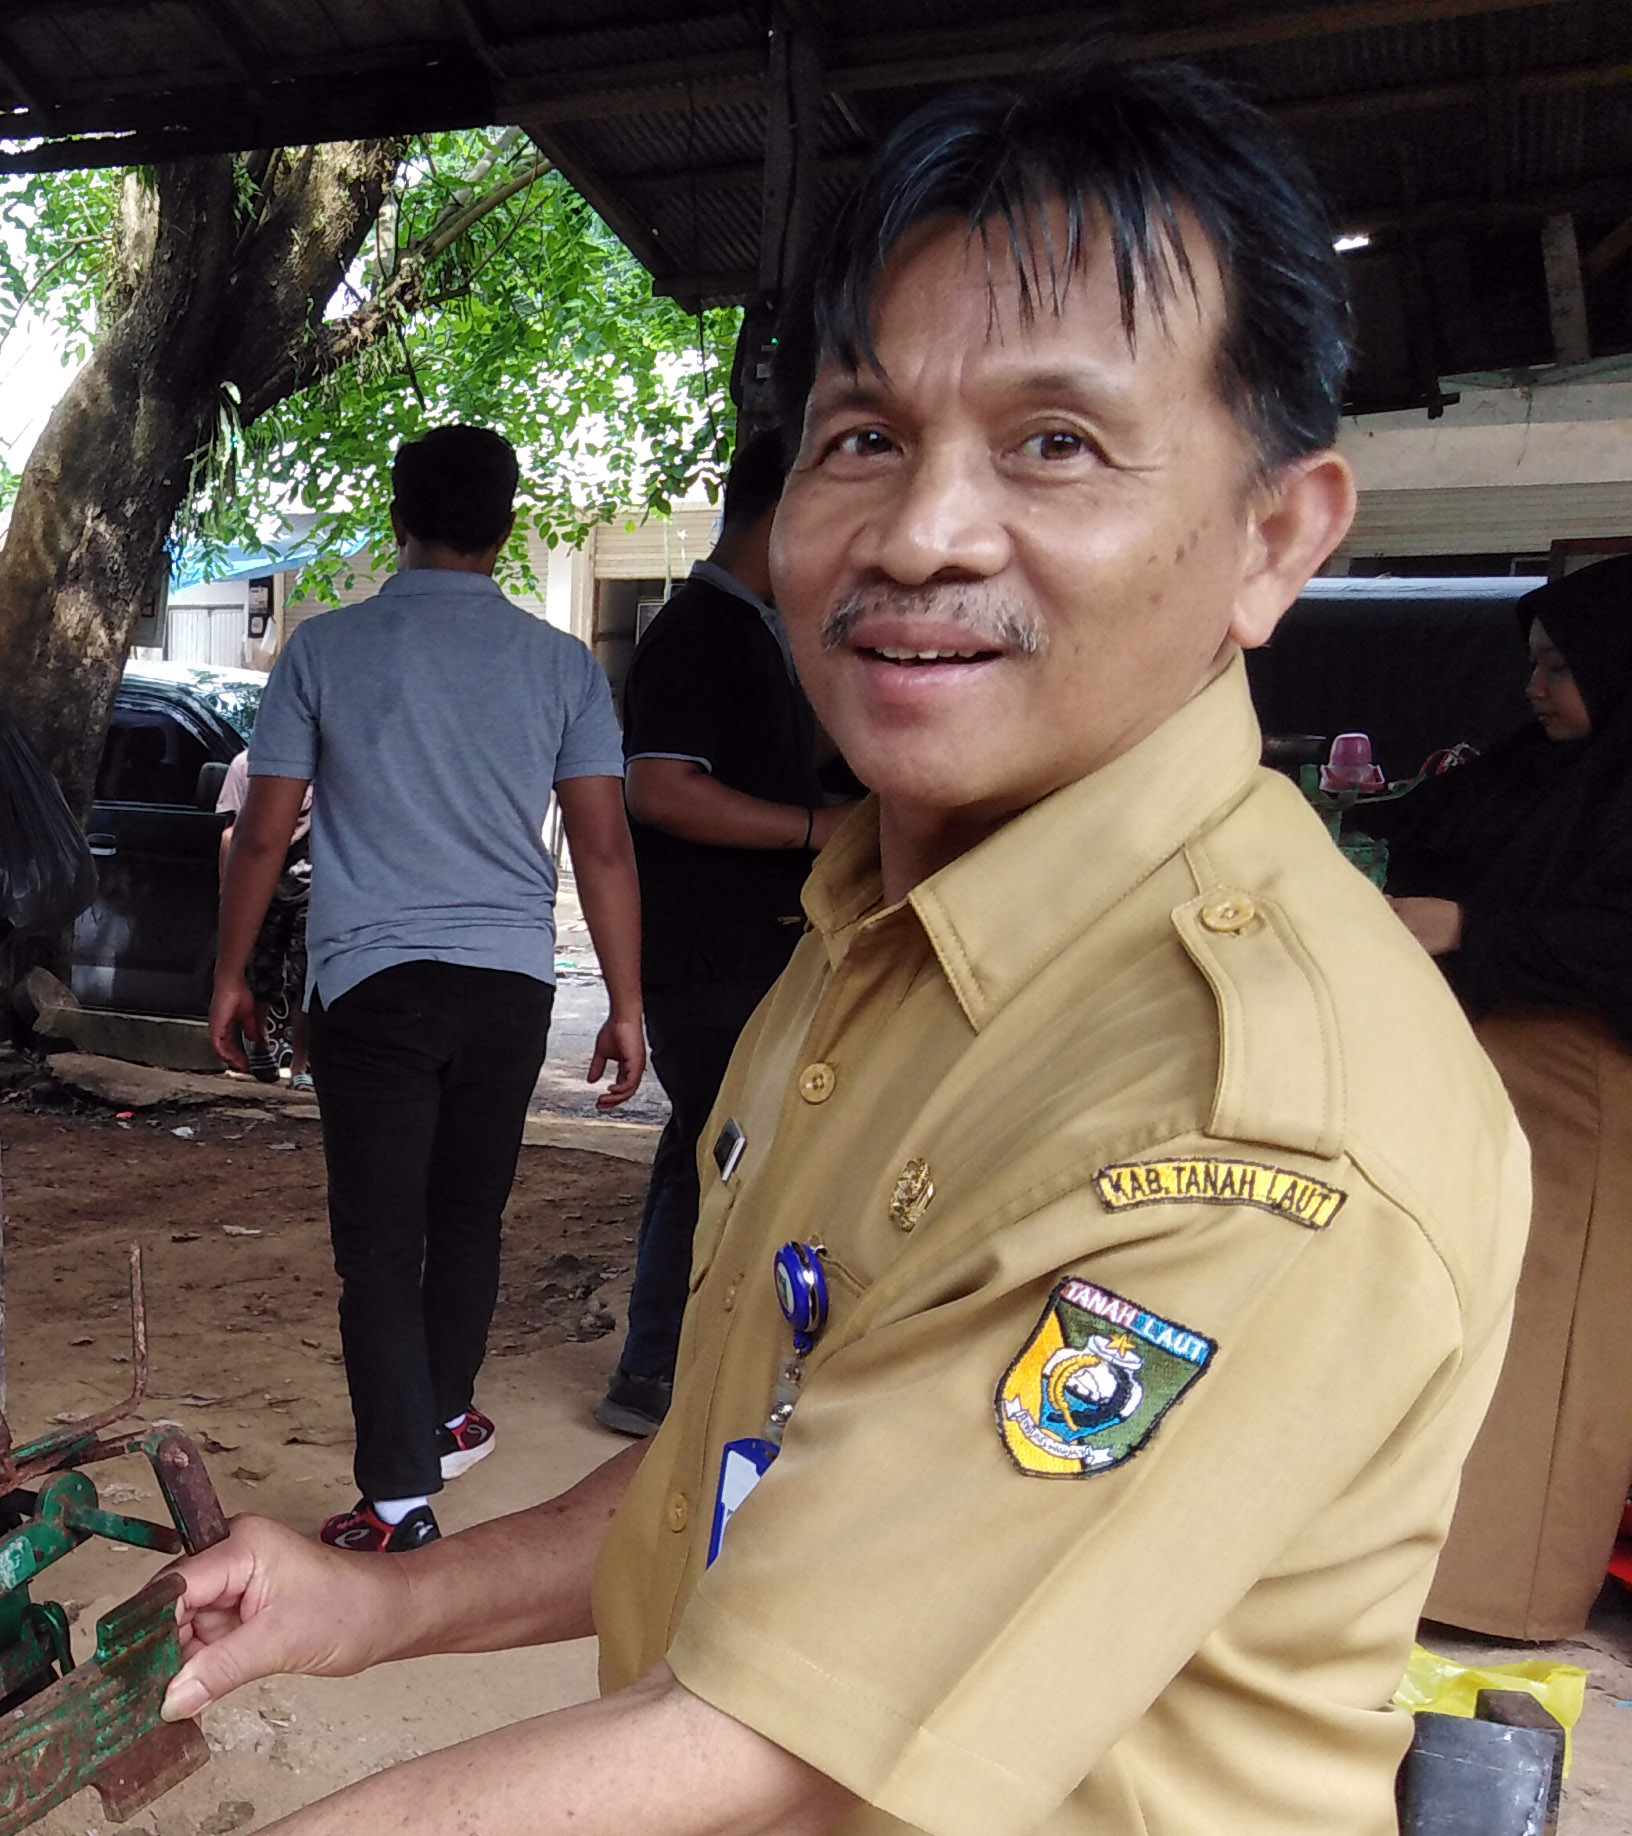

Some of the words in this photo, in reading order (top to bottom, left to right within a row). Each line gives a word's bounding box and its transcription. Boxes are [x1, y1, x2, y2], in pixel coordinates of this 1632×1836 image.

[1267, 1173, 1332, 1224] LAUT
[1068, 1280, 1138, 1328] TANAH
[1143, 1316, 1209, 1361] LAUT
